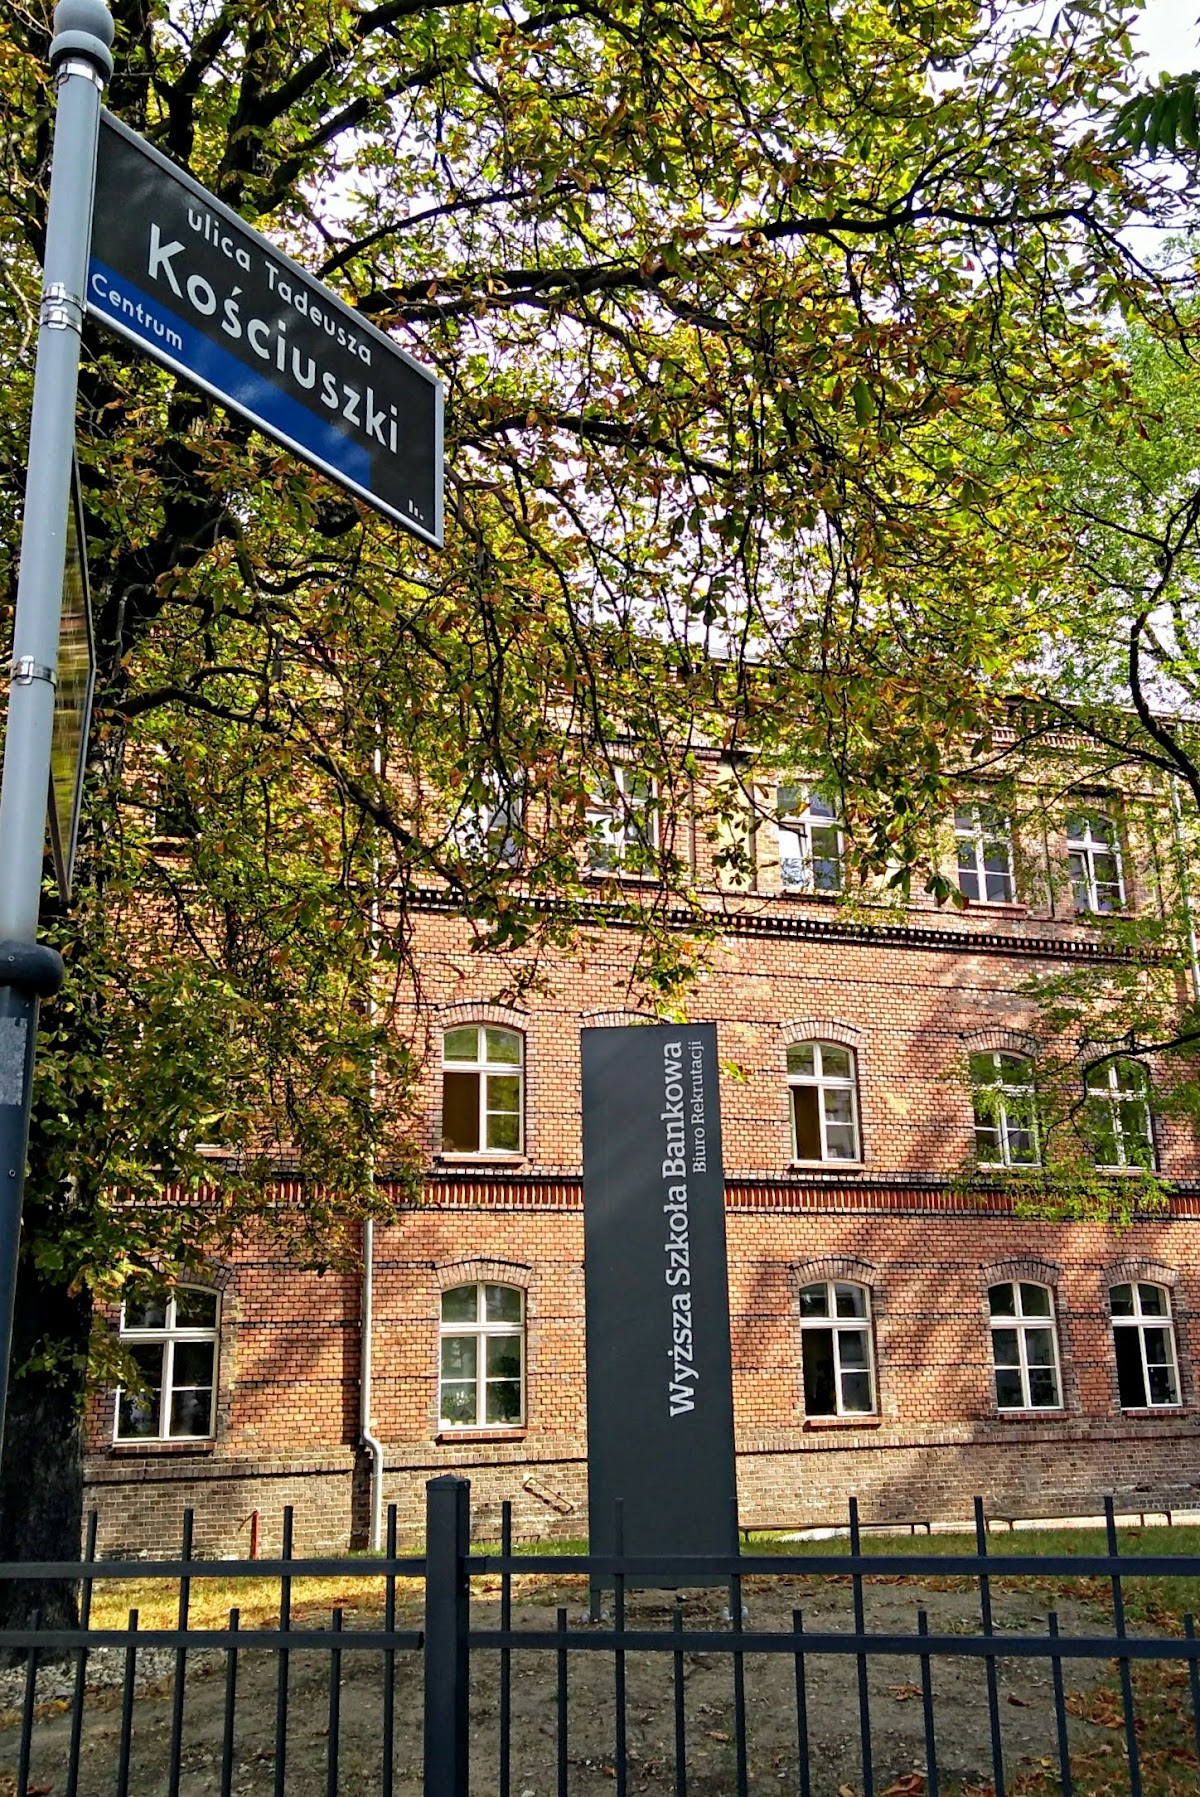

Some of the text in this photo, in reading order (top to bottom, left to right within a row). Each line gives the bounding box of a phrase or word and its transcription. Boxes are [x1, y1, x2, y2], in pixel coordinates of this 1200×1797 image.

[91, 273, 183, 350] Centrum
[148, 223, 398, 454] Kościuszki
[188, 208, 371, 366] ulica Tadeusza
[688, 1040, 707, 1173] Biuro Rekrutacji
[660, 1041, 700, 1417] Wyższa Szkoła Bankowa
